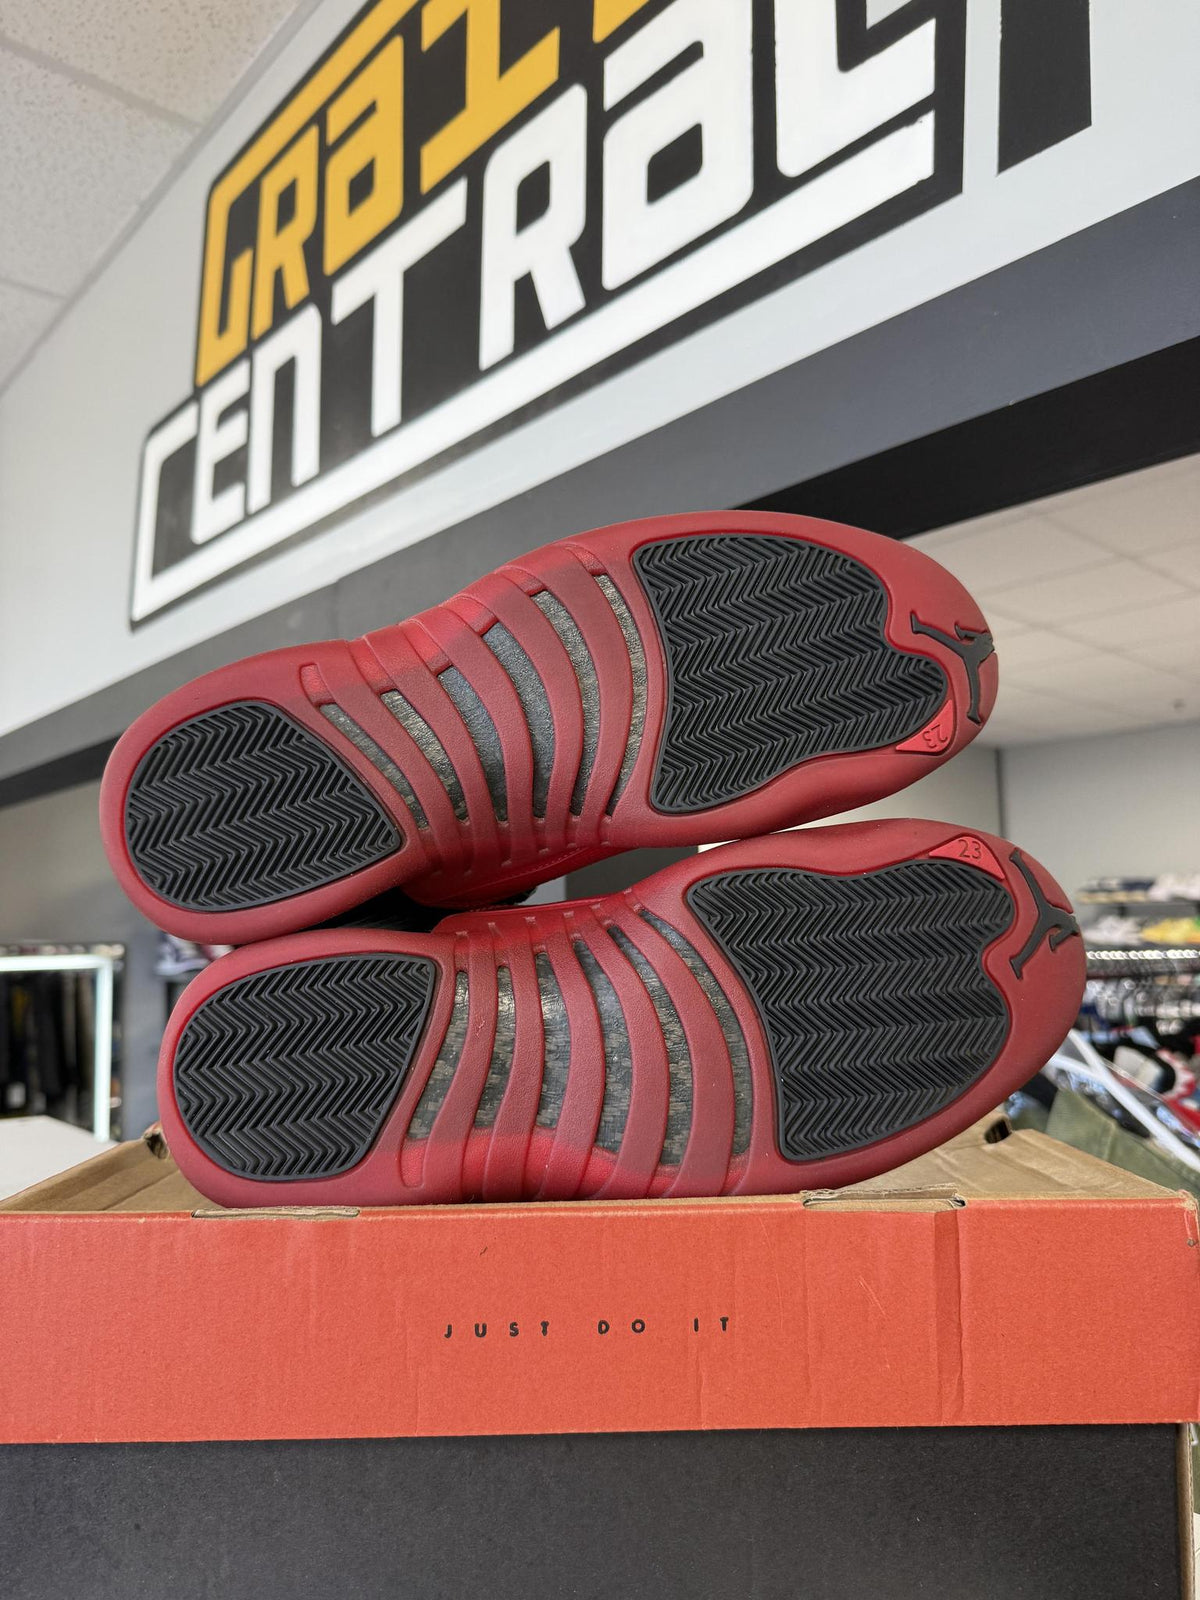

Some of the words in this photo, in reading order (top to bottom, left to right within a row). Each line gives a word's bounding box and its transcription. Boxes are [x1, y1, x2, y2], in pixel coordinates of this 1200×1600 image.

[922, 724, 949, 749] 23
[957, 839, 982, 860] 23
[444, 1320, 549, 1338] JUST
[597, 1318, 646, 1335] DO
[693, 1316, 729, 1332] IT
